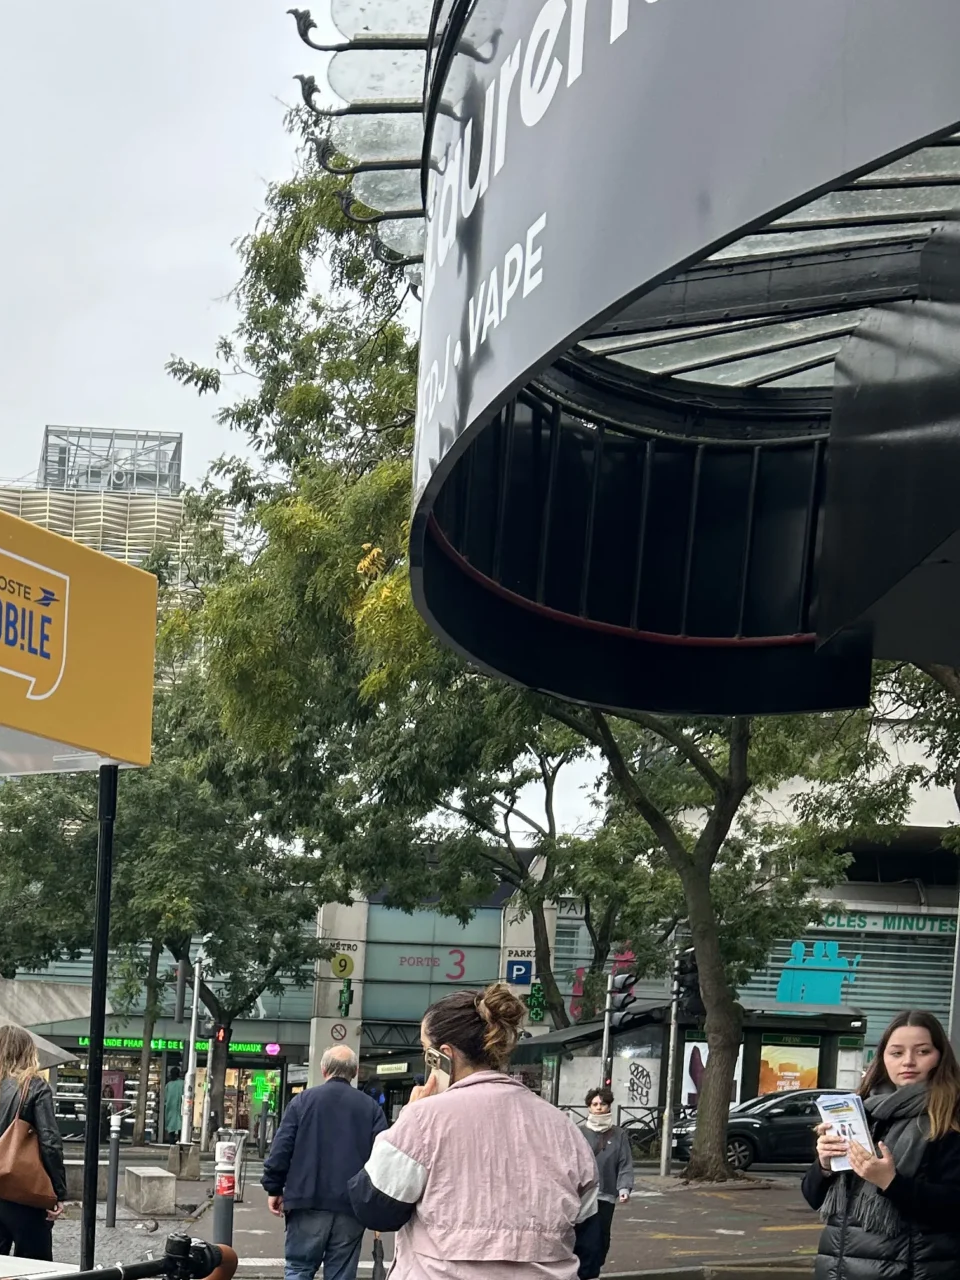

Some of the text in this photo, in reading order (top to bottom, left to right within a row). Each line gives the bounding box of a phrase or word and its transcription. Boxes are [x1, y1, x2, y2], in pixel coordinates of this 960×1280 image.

[468, 211, 547, 357] VAPE
[825, 912, 868, 929] CLES
[883, 915, 956, 933] MINUTES
[338, 958, 348, 973] 9
[399, 949, 465, 980] PORTE 3
[512, 965, 525, 980] P
[78, 1037, 89, 1046] LA
[103, 1038, 122, 1047] ANDE
[123, 1039, 166, 1050] PHARCIE
[167, 1041, 178, 1050] DE
